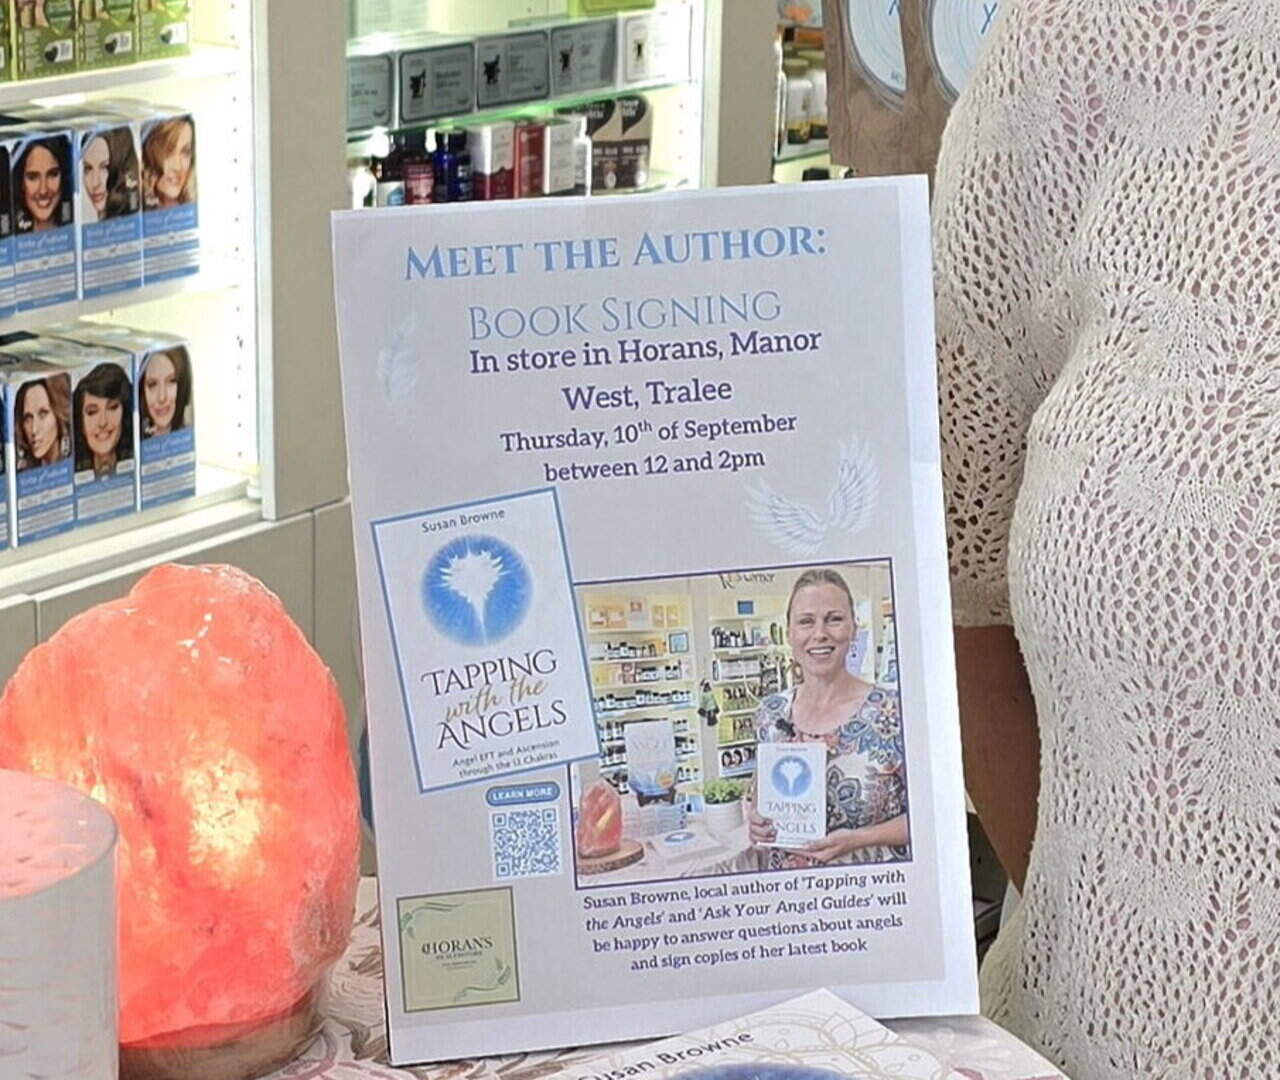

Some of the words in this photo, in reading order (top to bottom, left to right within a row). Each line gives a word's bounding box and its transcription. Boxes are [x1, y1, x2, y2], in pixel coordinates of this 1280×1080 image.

[405, 243, 522, 280] MEET
[535, 236, 620, 272] THE
[633, 225, 828, 267] AUTHOR:
[469, 304, 589, 341] BOOK
[602, 289, 782, 333] SIGNING
[469, 350, 500, 375] In
[506, 346, 577, 373] store
[583, 342, 612, 367] in
[619, 334, 724, 367] Horans,
[731, 328, 822, 357] Manor
[562, 384, 641, 412] West,
[646, 378, 733, 406] Tralee
[500, 428, 609, 454] Thursday,
[614, 420, 653, 445] 10th
[658, 419, 679, 441] of
[684, 412, 798, 445] September
[544, 457, 639, 483] between
[644, 454, 669, 477] 12
[673, 451, 714, 473] and
[718, 448, 766, 478] 2pm
[421, 516, 457, 534] Susan
[459, 507, 506, 527] Browne
[420, 648, 558, 697] TAPPING
[445, 683, 503, 724] with
[509, 675, 549, 705] the
[437, 699, 567, 751] ANGELS
[452, 752, 479, 769] Angel
[497, 747, 513, 759] and
[515, 739, 560, 755] Ascension
[458, 763, 495, 779] through
[496, 759, 511, 771] the
[523, 751, 558, 766] Chakras
[491, 790, 524, 802] LEARN
[525, 787, 554, 799] MORE
[583, 893, 627, 911] Susan
[631, 890, 691, 907] Browne,
[694, 882, 728, 900] local
[732, 879, 781, 897] author
[784, 876, 800, 892] of
[872, 869, 906, 886] with
[586, 916, 610, 932] the
[668, 907, 696, 924] and
[735, 900, 770, 919] Your
[776, 897, 819, 917] Angel
[877, 891, 908, 907] will
[592, 937, 612, 954] be
[614, 932, 660, 955] happy
[663, 932, 679, 947] to
[681, 927, 734, 945] answer
[738, 920, 808, 942] questions
[811, 915, 853, 934] about
[856, 911, 904, 934] angels
[631, 955, 659, 971] and
[661, 951, 692, 972] sign
[695, 947, 740, 969] copies
[742, 946, 758, 962] of
[760, 943, 786, 959] her
[788, 940, 828, 957] latest
[831, 936, 869, 954] book
[659, 1031, 754, 1066] Browne
